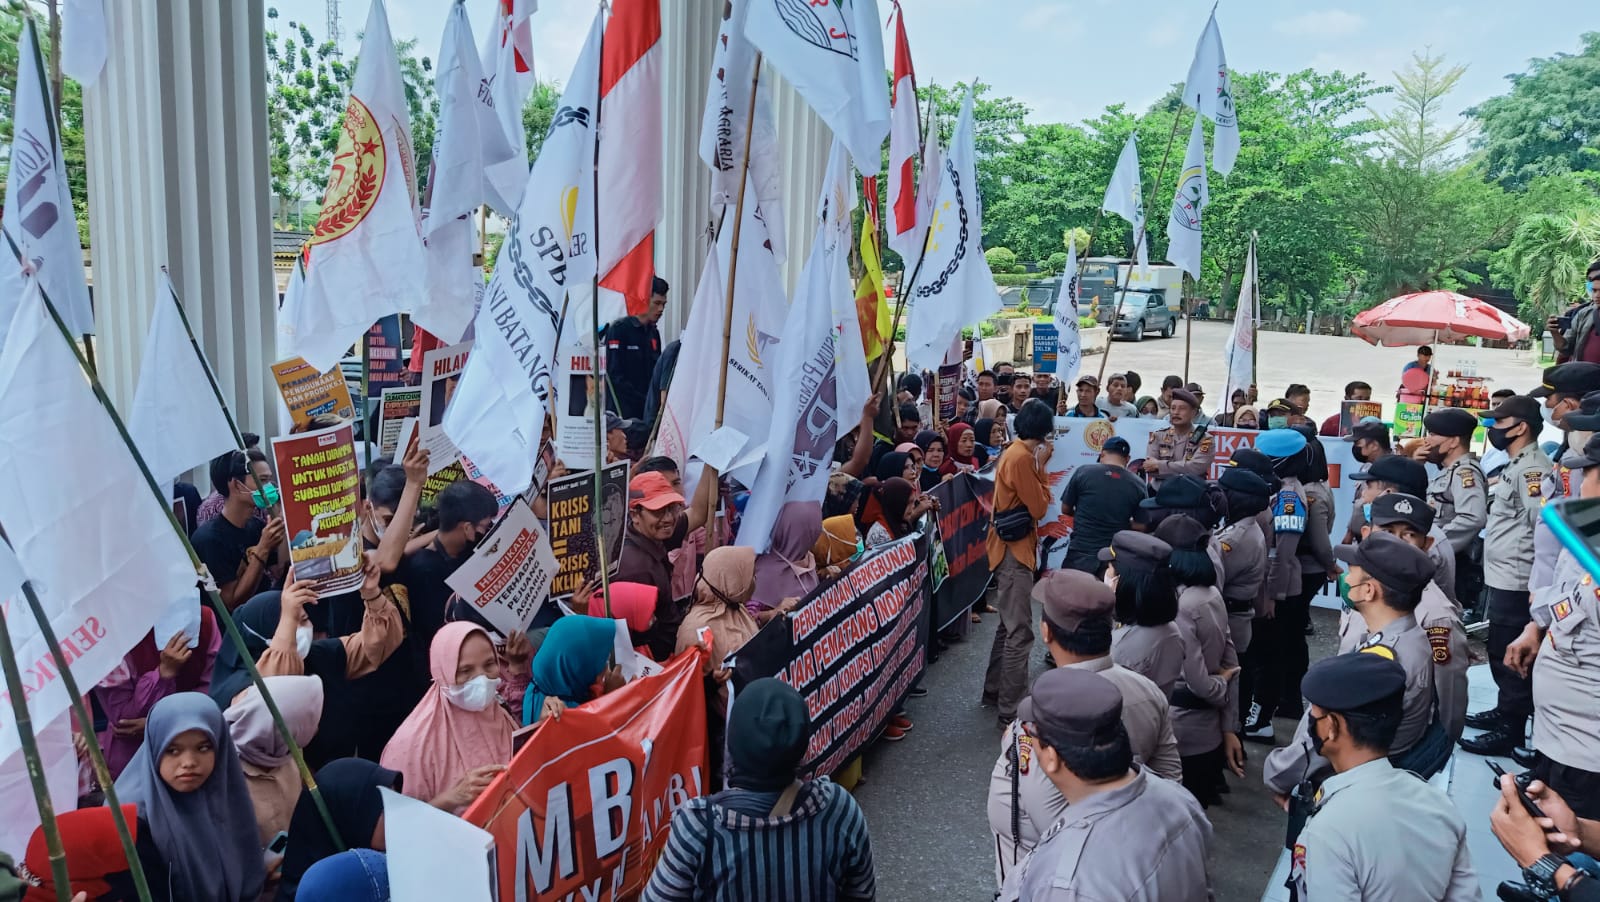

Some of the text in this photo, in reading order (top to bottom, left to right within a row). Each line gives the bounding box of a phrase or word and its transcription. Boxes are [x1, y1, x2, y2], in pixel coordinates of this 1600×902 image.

[717, 106, 734, 172] AGRARIA
[728, 358, 757, 383] SERIKAT
[291, 468, 327, 487] UNTUK
[292, 451, 326, 468] TANAH
[293, 483, 331, 502] SUBSIDI
[551, 494, 589, 520] KRISIS
[552, 516, 582, 538] TANI
[478, 532, 528, 590] HENTIKAN
[494, 547, 538, 606] TERHADAP
[507, 560, 541, 611] PEJUANG
[551, 572, 584, 595] IKLIM
[515, 567, 545, 617] AGRARIA
[792, 575, 856, 646] PERUSAHAAN
[849, 539, 917, 598] PERKEBUNAN
[813, 603, 879, 677] PEMATANG
[838, 646, 874, 698] KORUPSI
